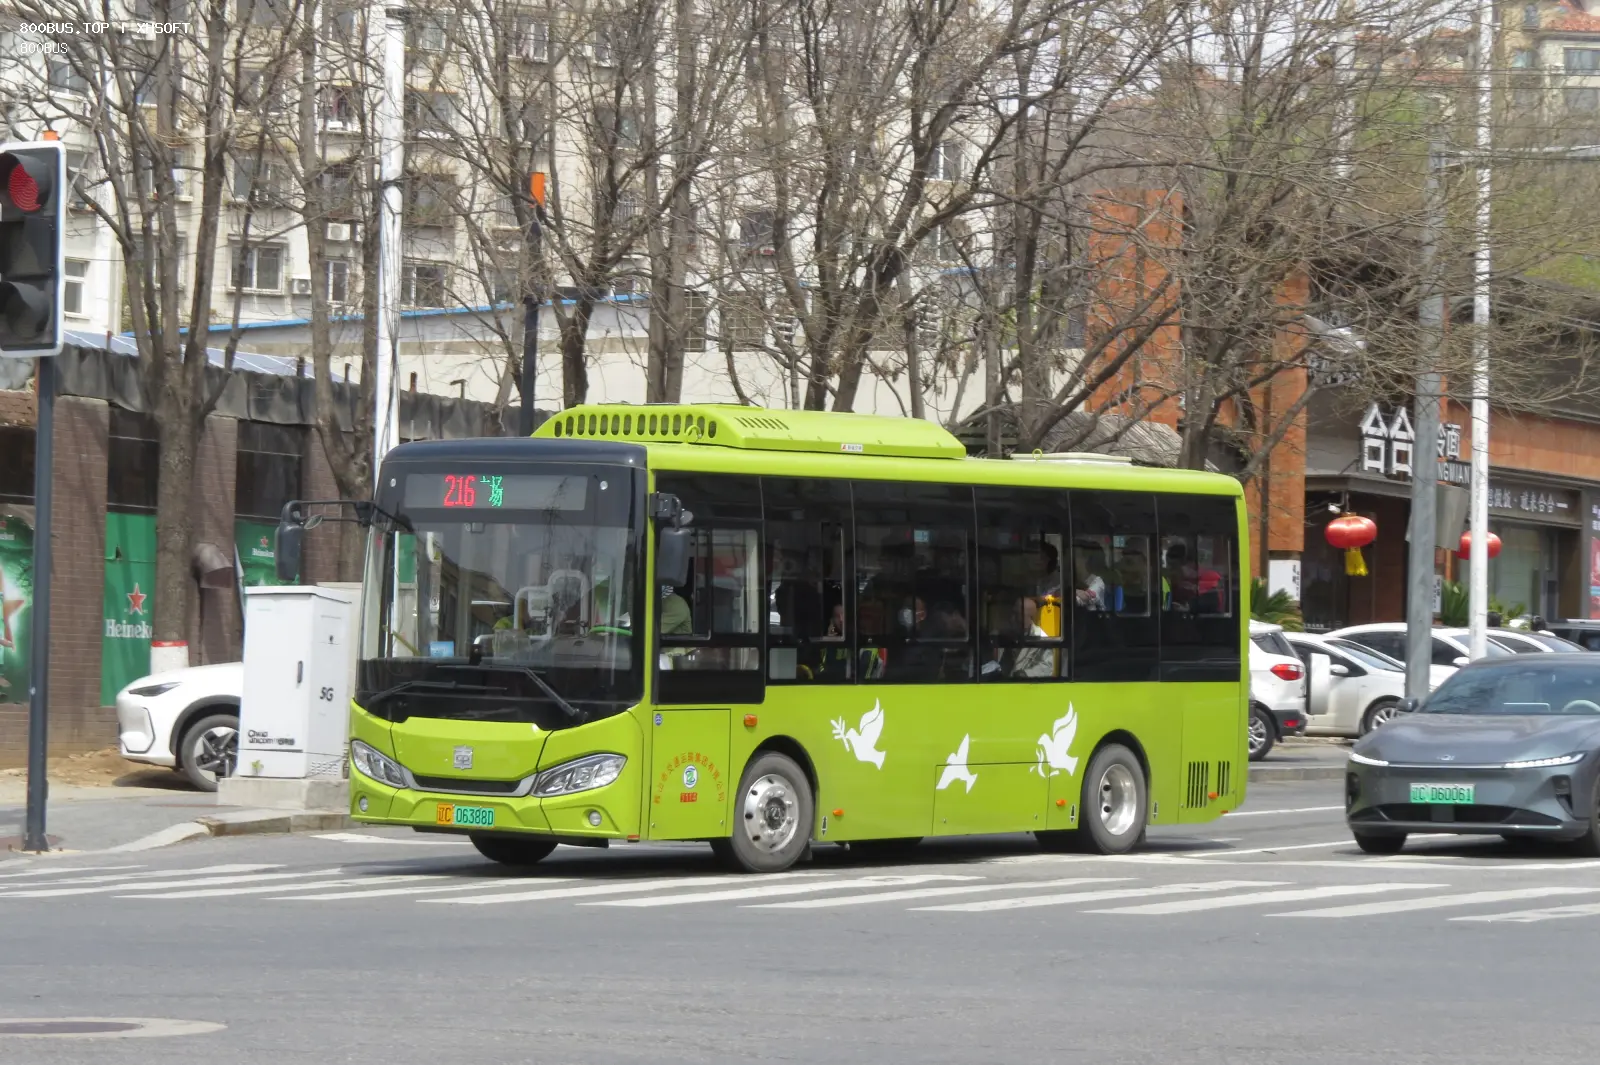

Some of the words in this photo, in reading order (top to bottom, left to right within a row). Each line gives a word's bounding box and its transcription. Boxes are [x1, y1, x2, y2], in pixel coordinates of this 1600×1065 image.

[1437, 463, 1472, 484] NGMIAN
[444, 475, 476, 507] 216
[104, 618, 153, 639] Heinek
[319, 686, 334, 702] 5G
[1430, 786, 1472, 802] D60061
[455, 807, 495, 826] 06388D
